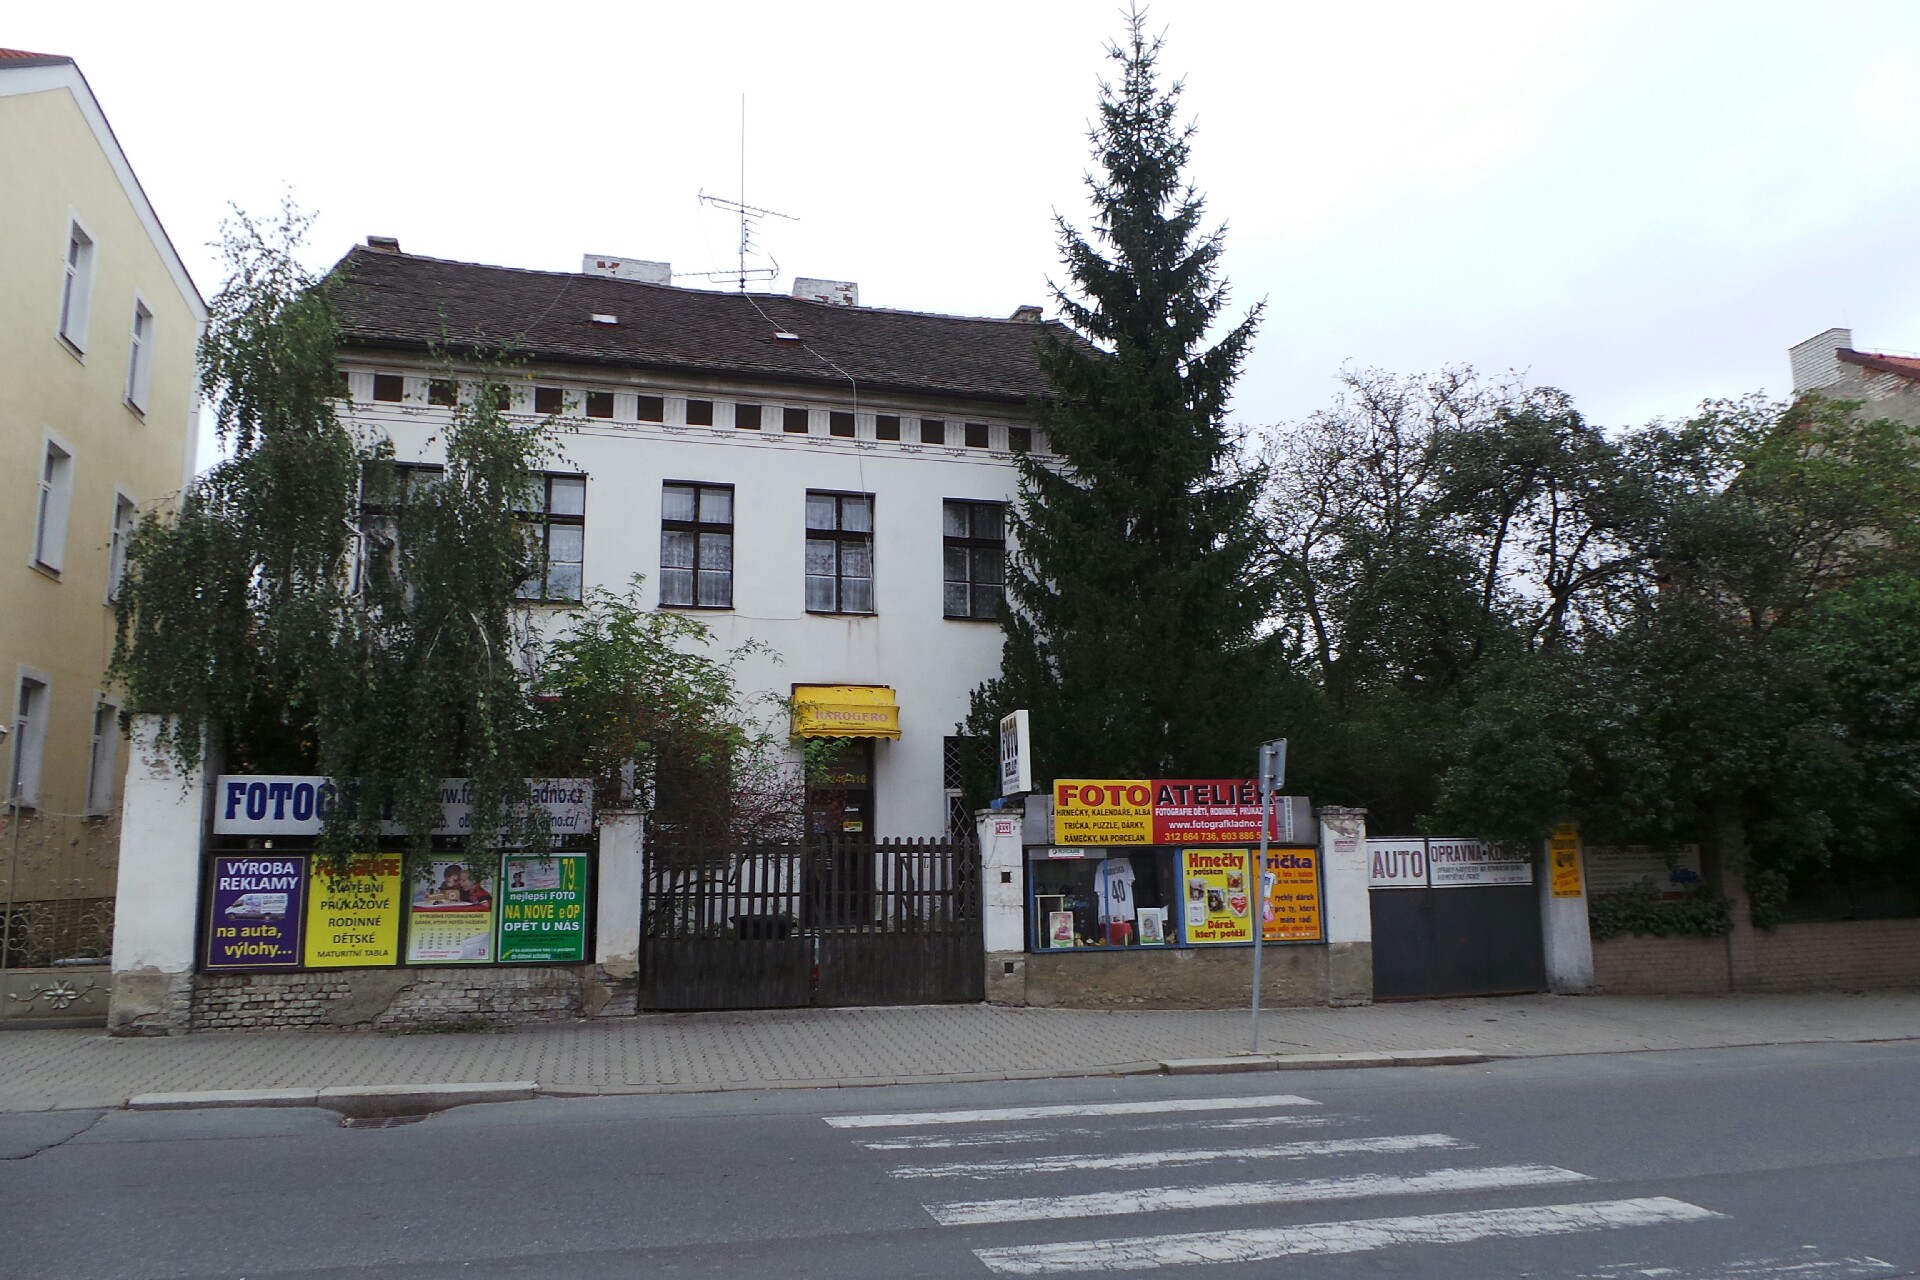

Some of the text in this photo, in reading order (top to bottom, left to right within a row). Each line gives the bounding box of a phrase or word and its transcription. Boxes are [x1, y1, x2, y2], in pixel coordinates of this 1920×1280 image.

[1058, 785, 1150, 807] FOTO
[1056, 808, 1090, 817] HRNEČKY,
[1155, 807, 1193, 816] FOTOGRAFIE
[1064, 821, 1090, 830] TRIČKA,
[1093, 822, 1120, 830] PUZZLE,
[1168, 820, 1263, 830] www.fotografkladno.c
[1100, 834, 1109, 842] NA
[1165, 832, 1181, 841] 312
[1202, 832, 1219, 842] 736,
[1221, 832, 1237, 841] 603
[1239, 832, 1254, 841] 886
[227, 859, 295, 875] VÝROBA
[1188, 853, 1244, 870] Hrnečky
[1372, 850, 1423, 878] AUTO
[562, 858, 575, 890] 79
[220, 877, 298, 890] REKLAMY
[510, 891, 576, 902] nejlepší FOTO
[1112, 879, 1126, 903] 40
[505, 905, 520, 918] NA
[524, 902, 554, 918] NOVÉ
[328, 915, 381, 927] RODINNÉ
[504, 920, 579, 931] OPĚT U NÁS
[217, 925, 283, 938] na auta,
[333, 932, 376, 944] DĚTSKÉ
[225, 942, 293, 958] výlohy...
[364, 949, 389, 957] TABLA
